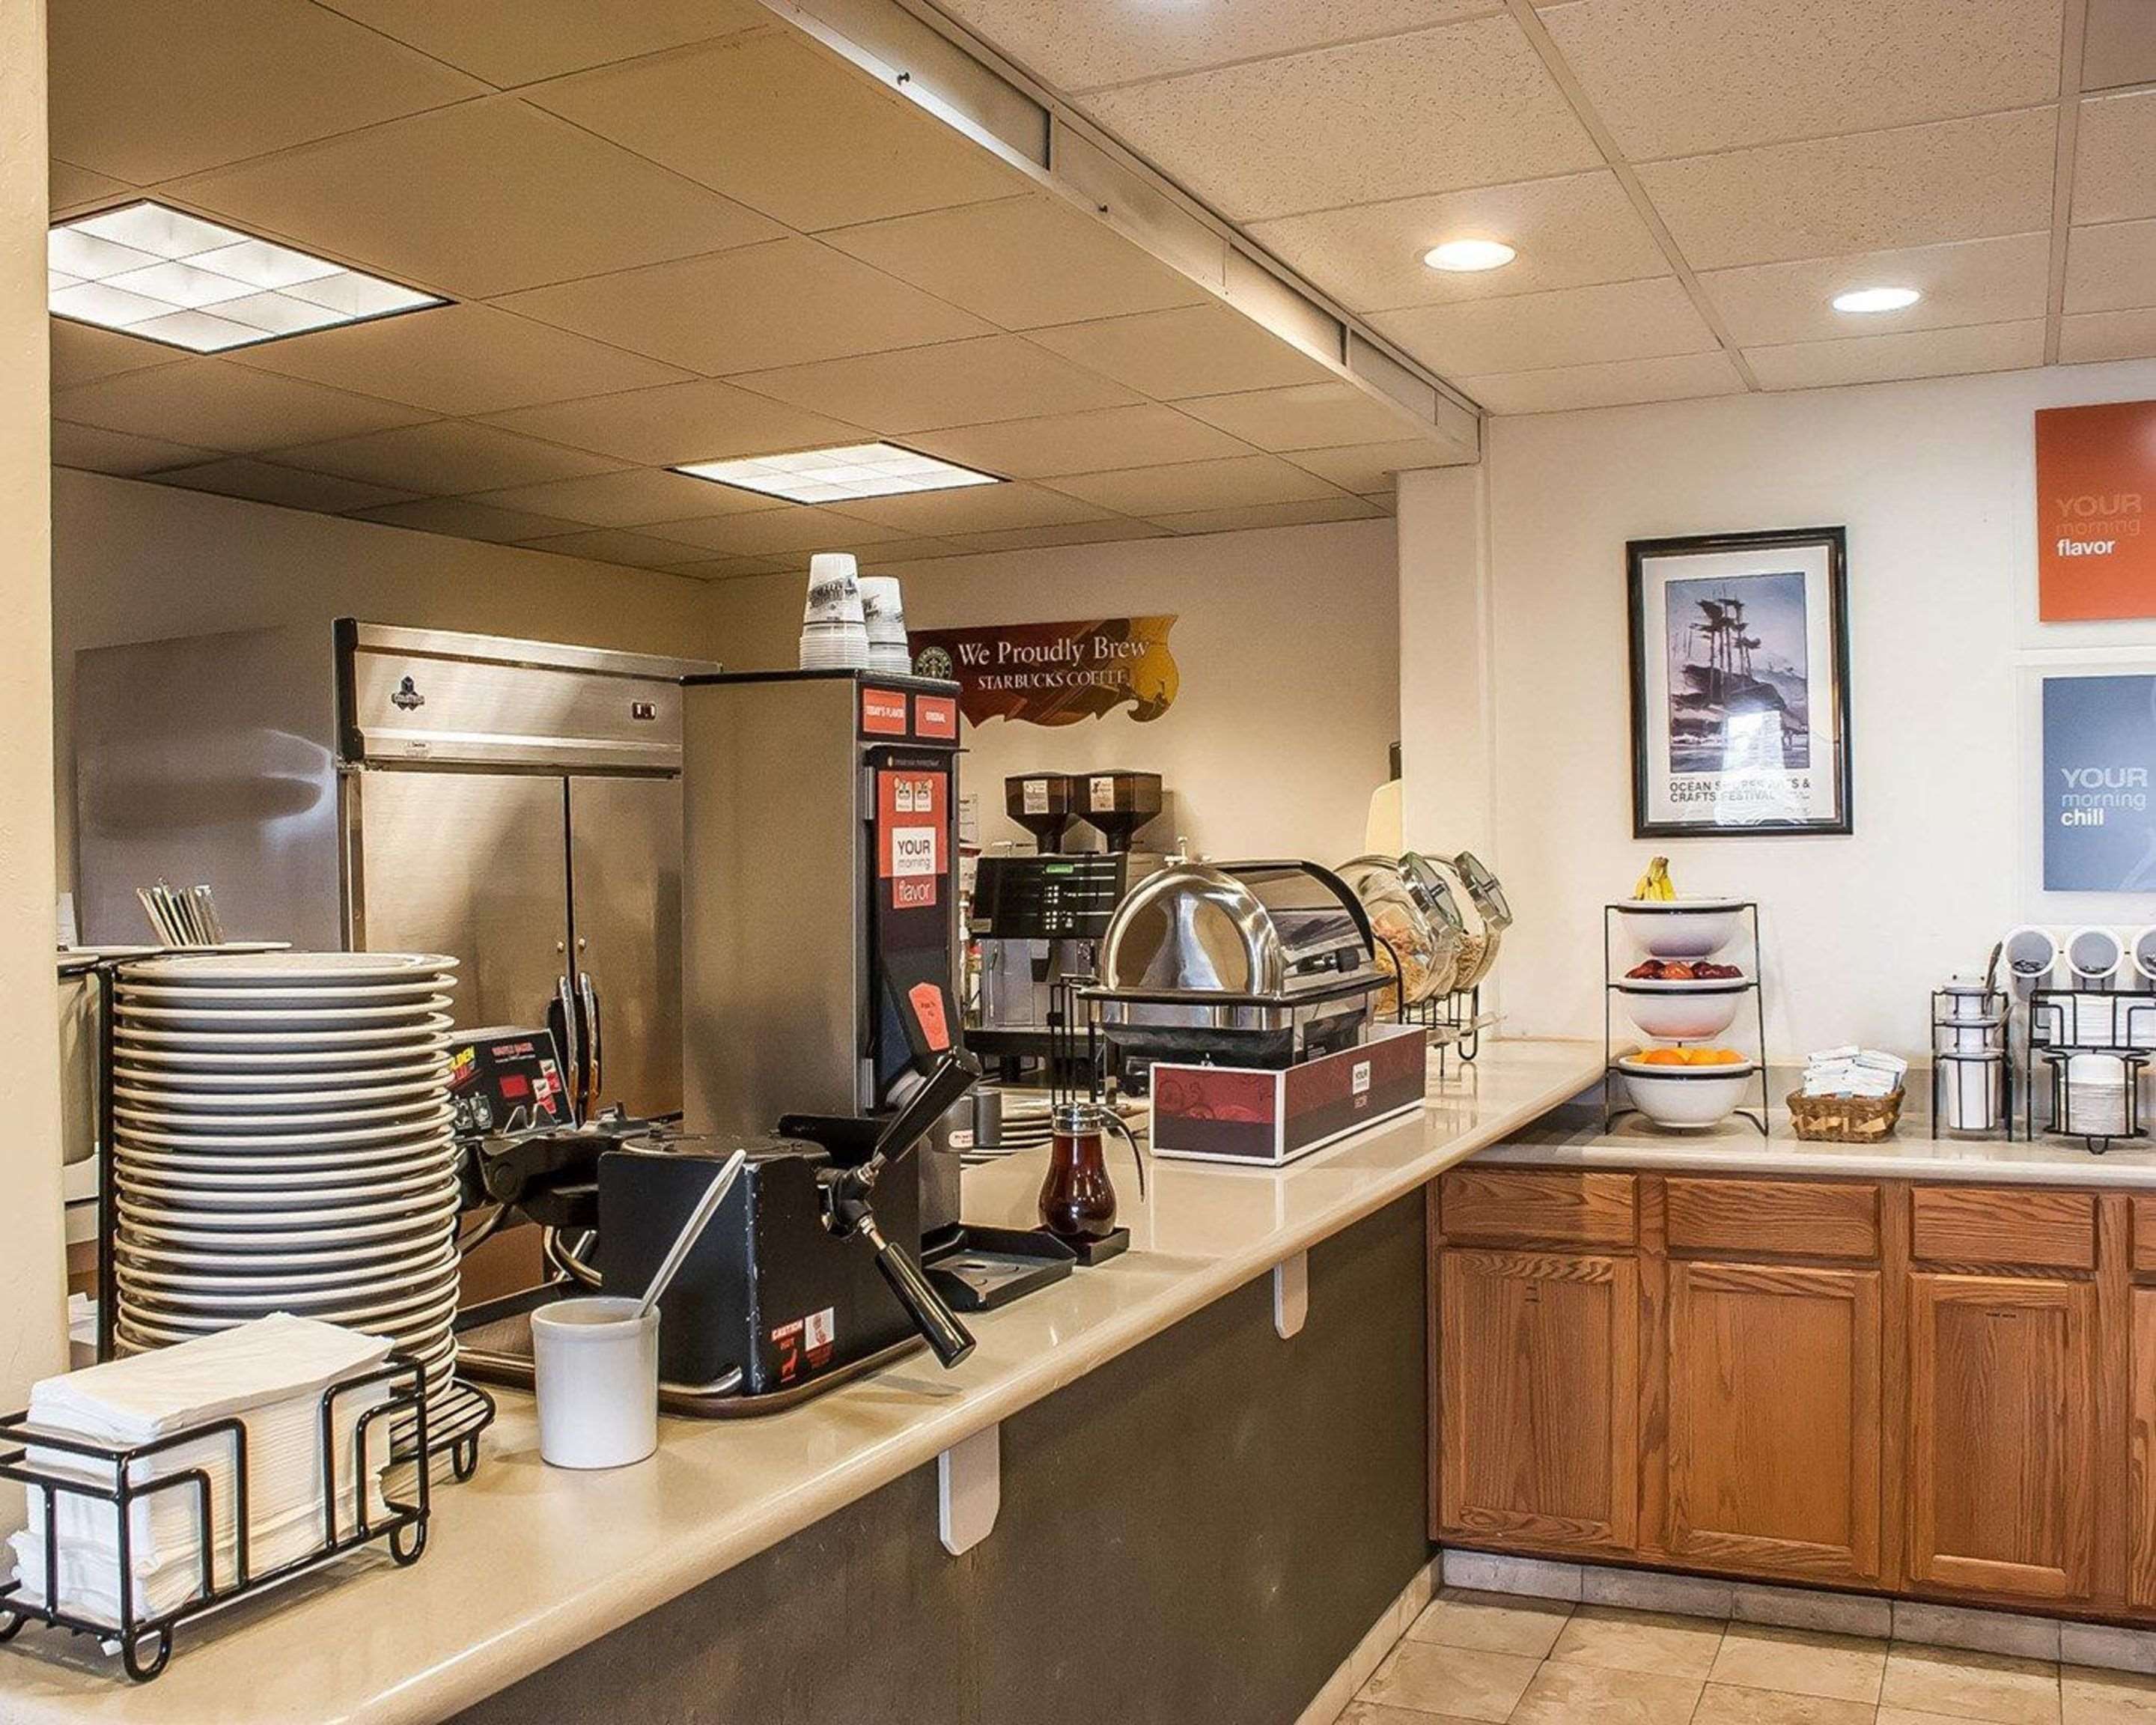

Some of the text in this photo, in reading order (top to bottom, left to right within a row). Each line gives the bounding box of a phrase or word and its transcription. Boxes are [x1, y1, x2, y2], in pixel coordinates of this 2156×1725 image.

[2056, 493, 2142, 517] YOUR
[2056, 520, 2140, 536] morning
[2056, 539, 2116, 556] flavor
[958, 636, 1150, 666] We Proudly Brew
[978, 672, 1064, 690] STARBUCKS
[1669, 781, 1711, 792] OCEAN
[1803, 778, 1810, 788] &
[2061, 767, 2148, 788] YOUR
[1669, 791, 1717, 803] CRAFTS
[2061, 792, 2146, 811] morning
[2061, 808, 2104, 826] chill
[898, 839, 931, 855] YOUR
[898, 879, 931, 903] flavor
